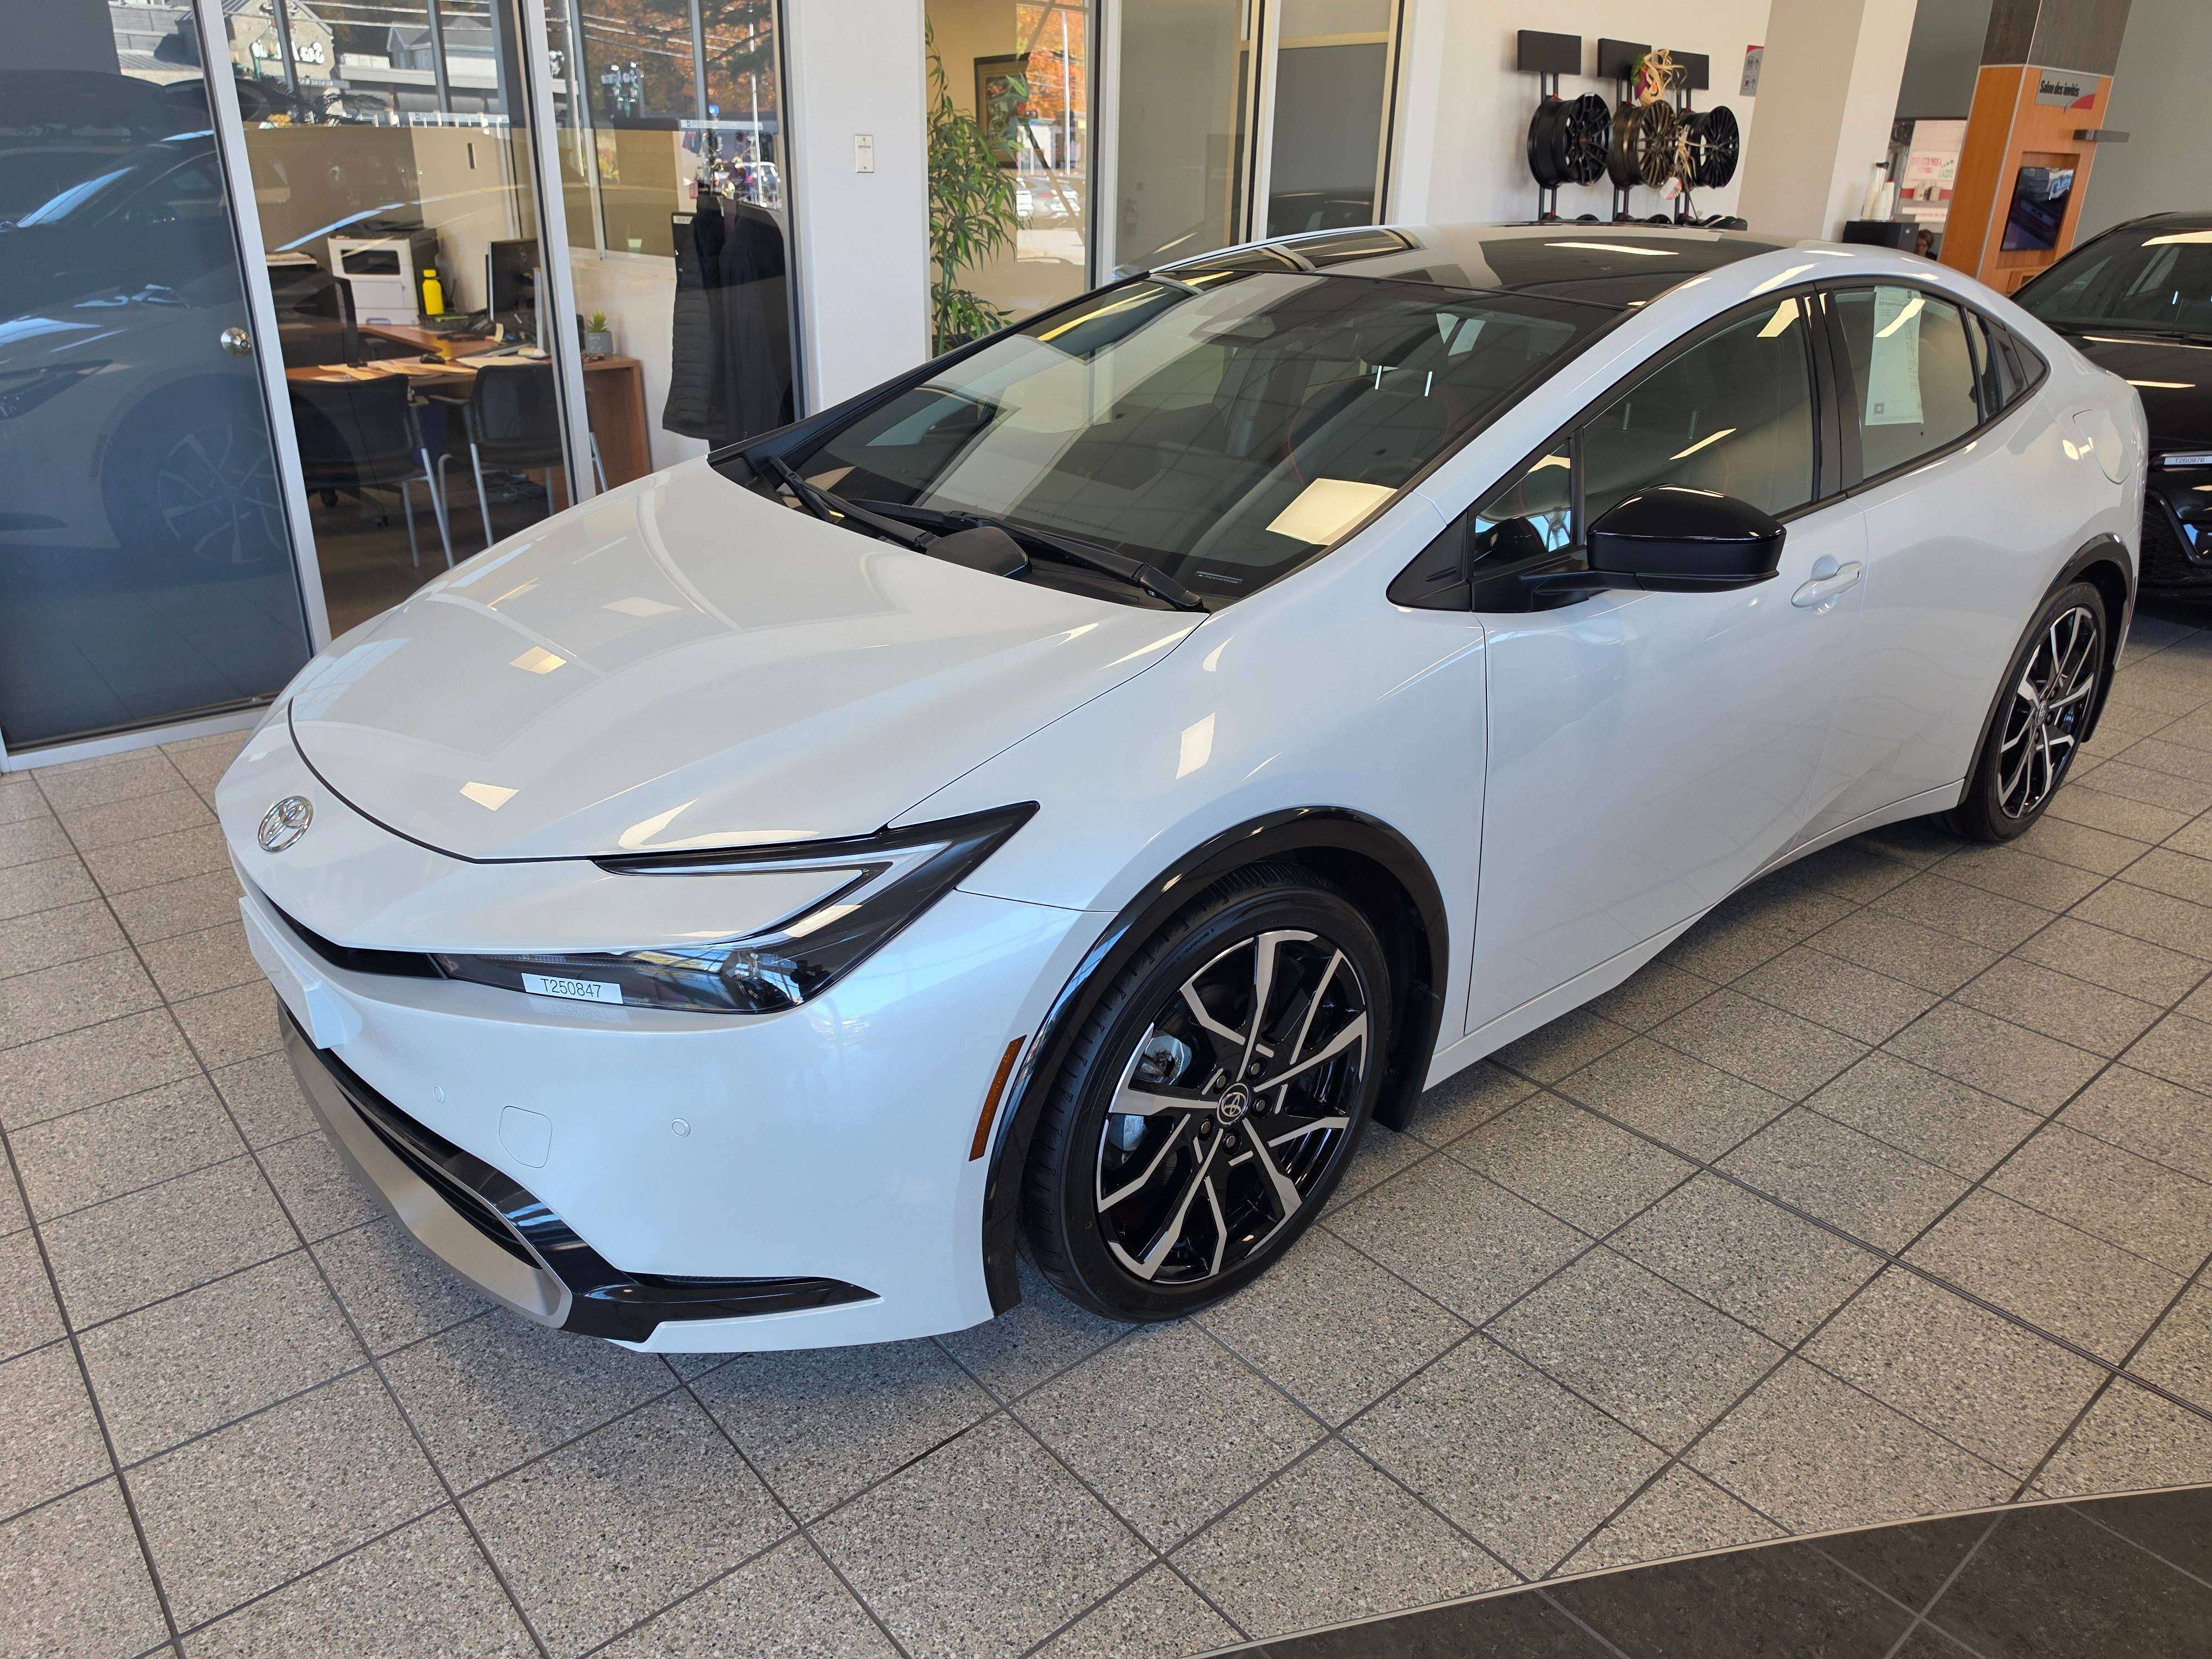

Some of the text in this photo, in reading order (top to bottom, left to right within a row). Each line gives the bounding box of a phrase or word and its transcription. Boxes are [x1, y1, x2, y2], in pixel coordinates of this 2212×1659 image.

[2039, 80, 2080, 97] Salon des invités
[540, 978, 601, 998] T250847
